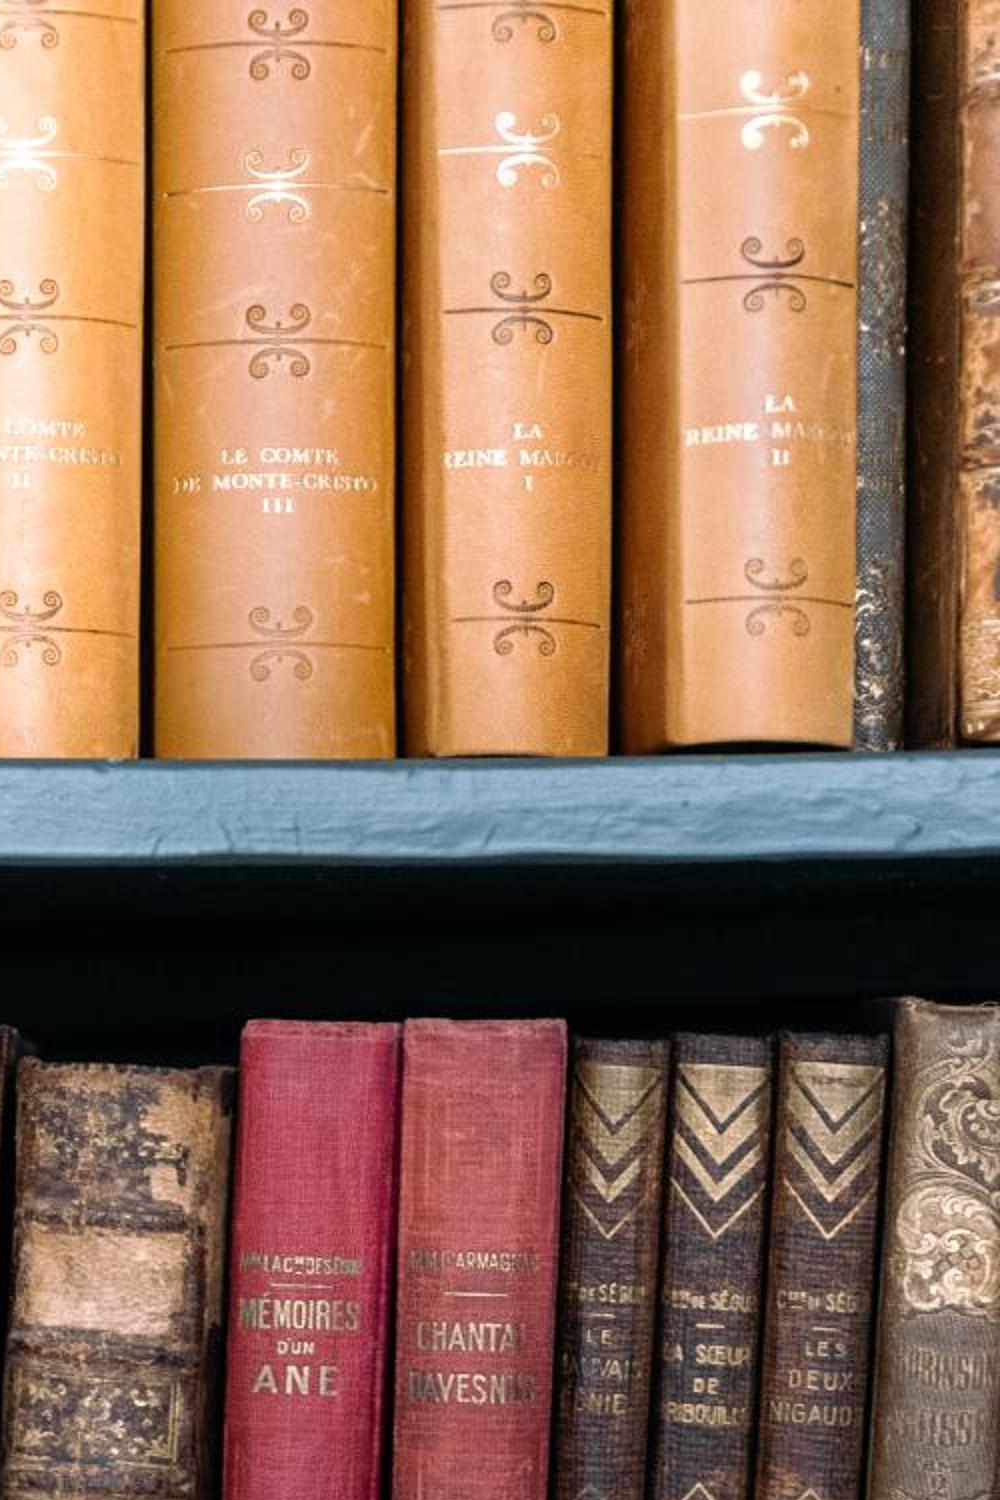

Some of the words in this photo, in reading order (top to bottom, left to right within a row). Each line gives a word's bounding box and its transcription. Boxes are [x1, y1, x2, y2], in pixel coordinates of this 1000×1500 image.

[765, 394, 795, 412] LA
[513, 423, 544, 439] LA
[685, 422, 759, 446] REINE
[221, 449, 249, 465] LE
[260, 448, 338, 465] COMTE
[213, 472, 377, 492] MONTE-CRISTO
[262, 498, 294, 513] III
[240, 1292, 360, 1331] MÉMOIRES
[805, 1341, 848, 1357] LES
[789, 1369, 853, 1392] DEUX
[769, 1401, 860, 1427] NIGAUD
